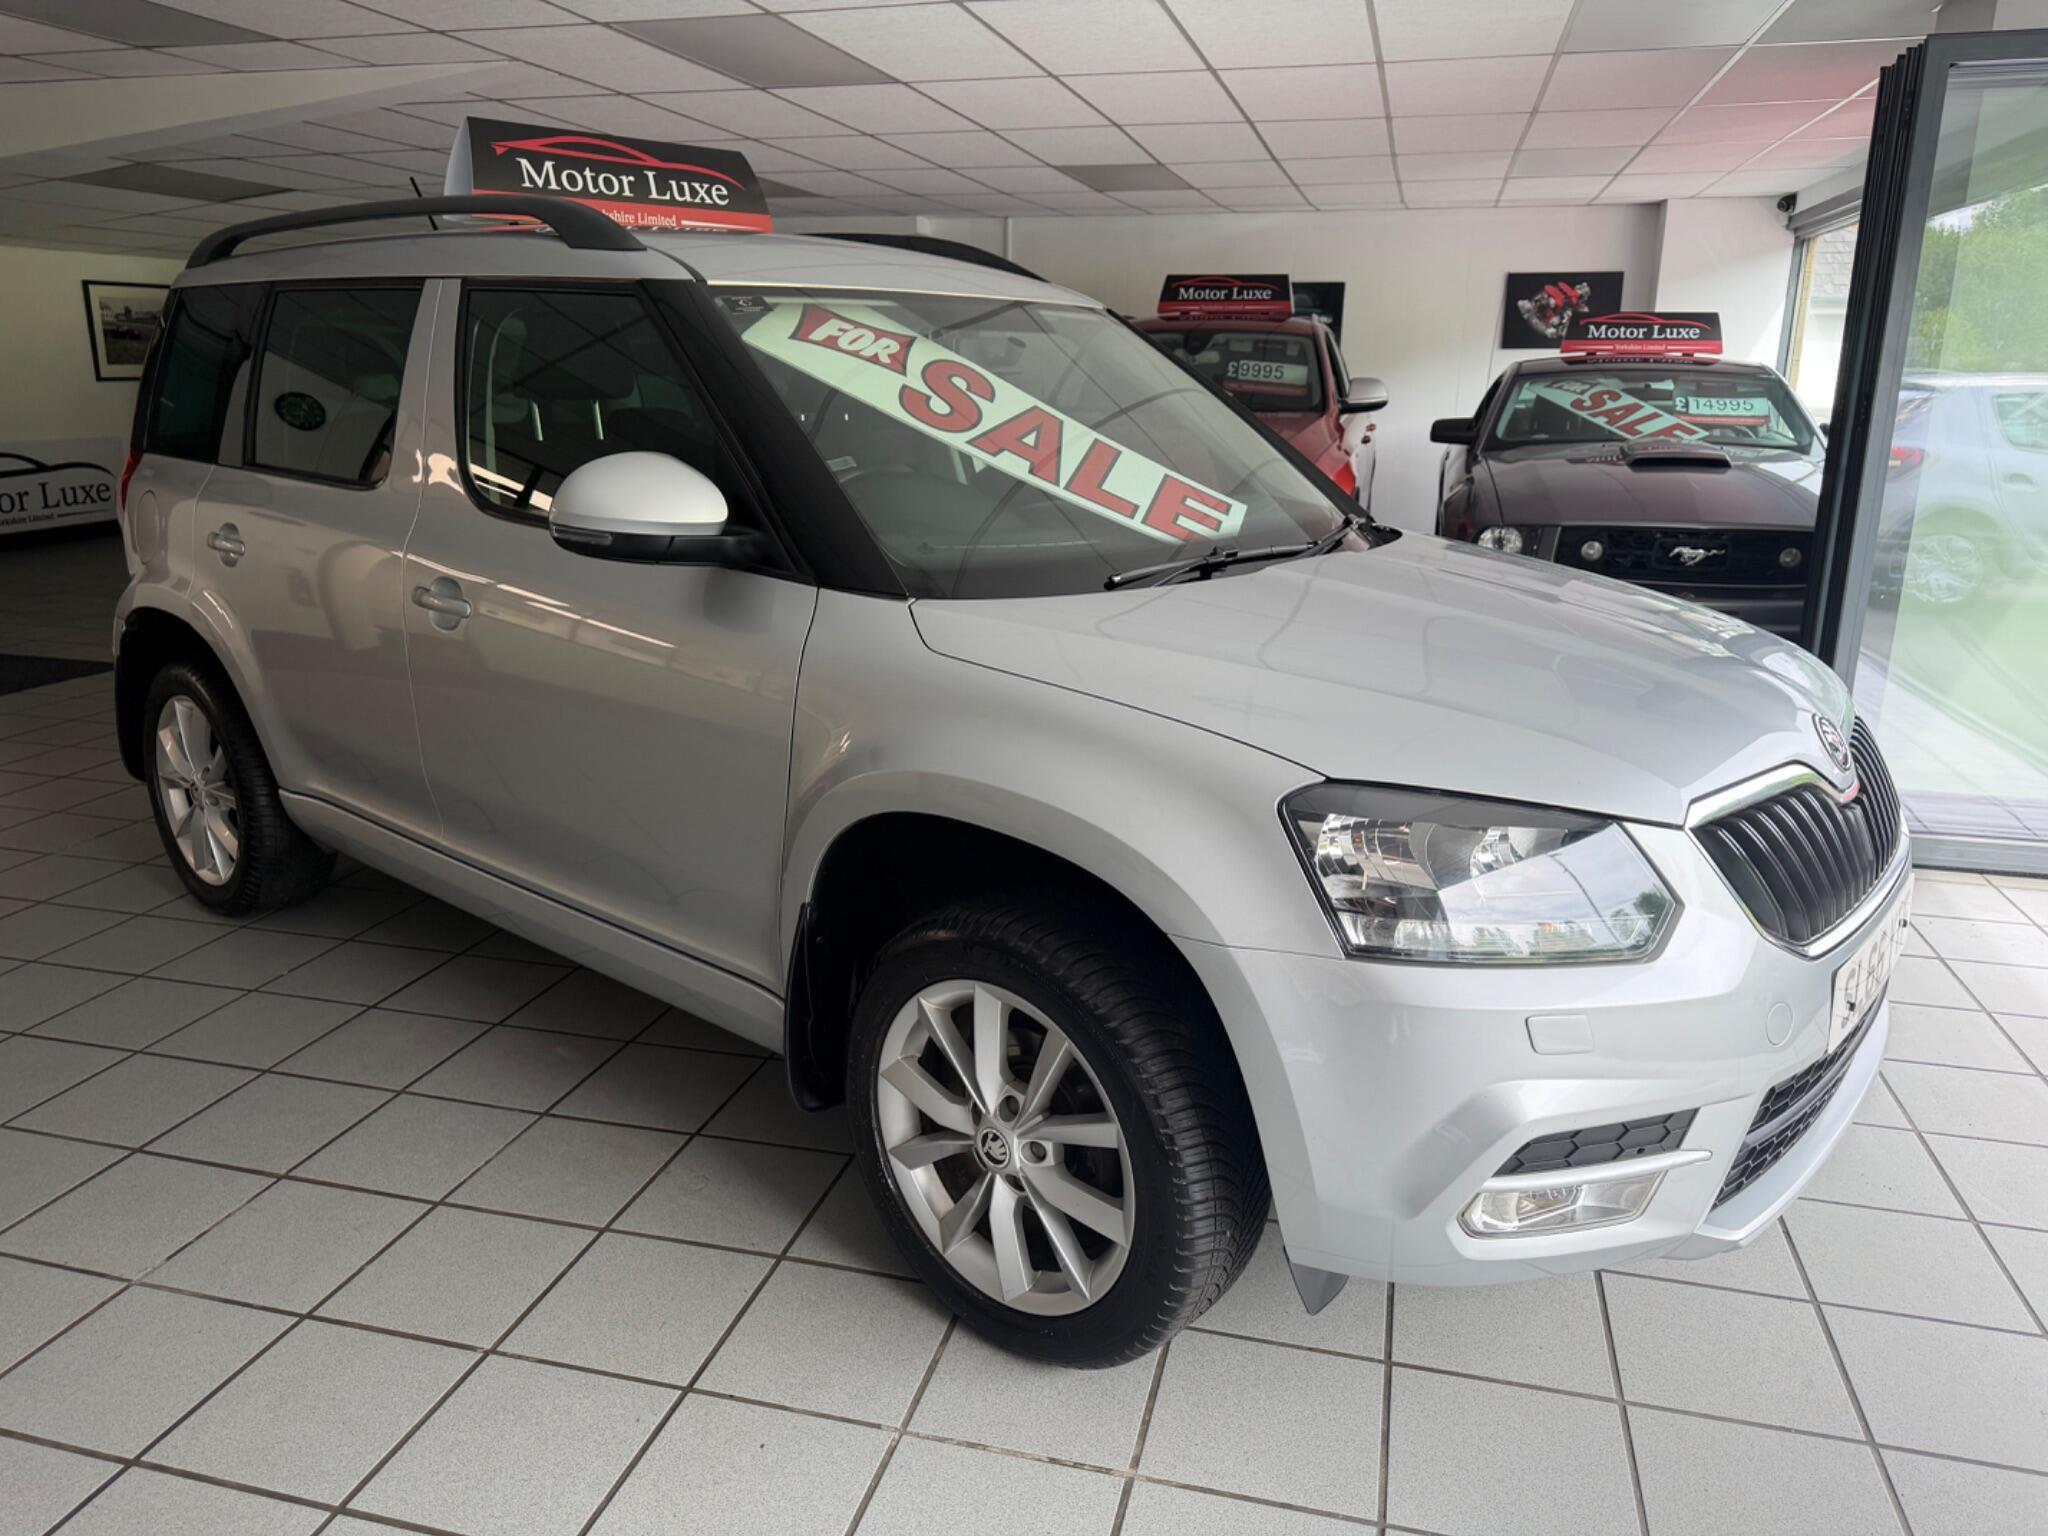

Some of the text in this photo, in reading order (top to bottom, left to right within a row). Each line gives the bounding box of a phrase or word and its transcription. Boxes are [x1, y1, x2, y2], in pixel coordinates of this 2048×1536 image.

[516, 157, 730, 206] Motor Luxe
[637, 212, 677, 227] Limited
[1179, 287, 1272, 300] Motor Luxe
[809, 318, 902, 366] FOR
[1587, 324, 1701, 339] Motor Luxe
[1227, 361, 1285, 380] £9995
[898, 358, 1233, 542] SALE
[38, 481, 112, 510] Luxe
